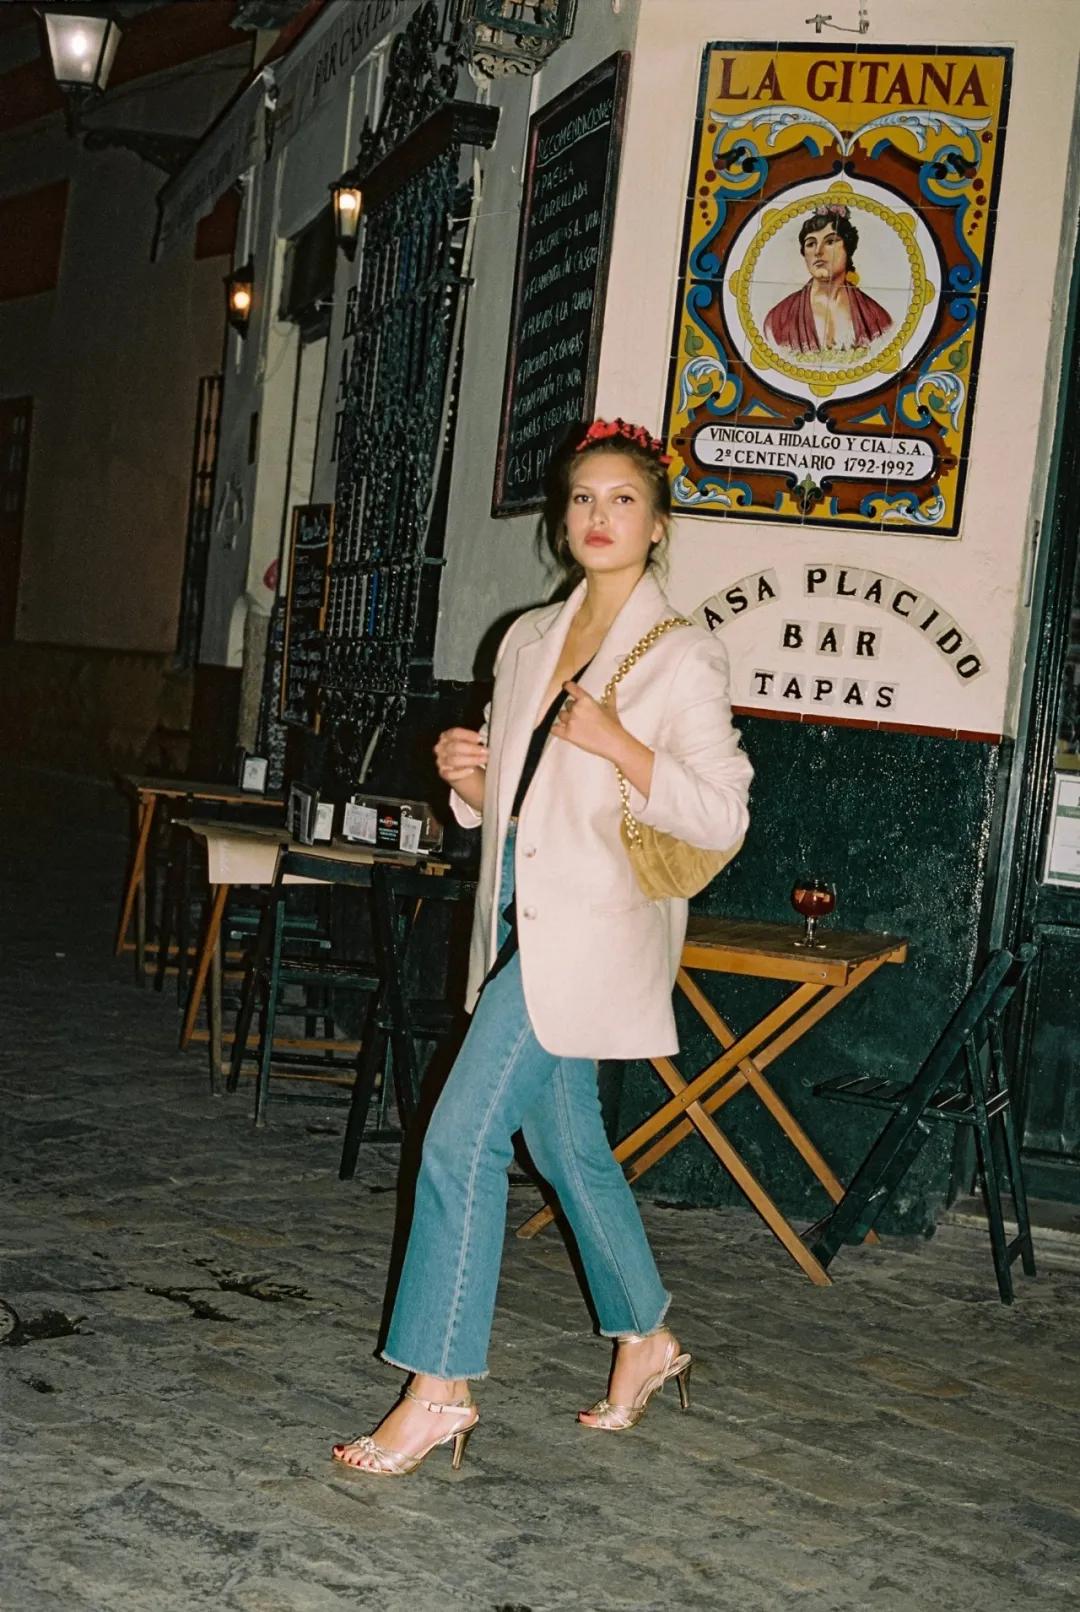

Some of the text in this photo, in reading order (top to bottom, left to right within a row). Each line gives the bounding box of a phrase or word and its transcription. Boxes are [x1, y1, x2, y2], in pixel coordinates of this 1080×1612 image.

[717, 57, 989, 107] LA GITANA
[710, 427, 774, 446] VINICOLA
[778, 432, 841, 450] HIDALGO
[846, 437, 854, 451] Y
[896, 441, 927, 457] S.A.
[507, 450, 533, 486] CASA
[734, 450, 836, 471] CENTENARIO
[844, 457, 915, 476] 1792-1992
[704, 568, 982, 679] ASA PLACIDO
[782, 623, 877, 657] BAR
[754, 672, 894, 708] TAPAS
